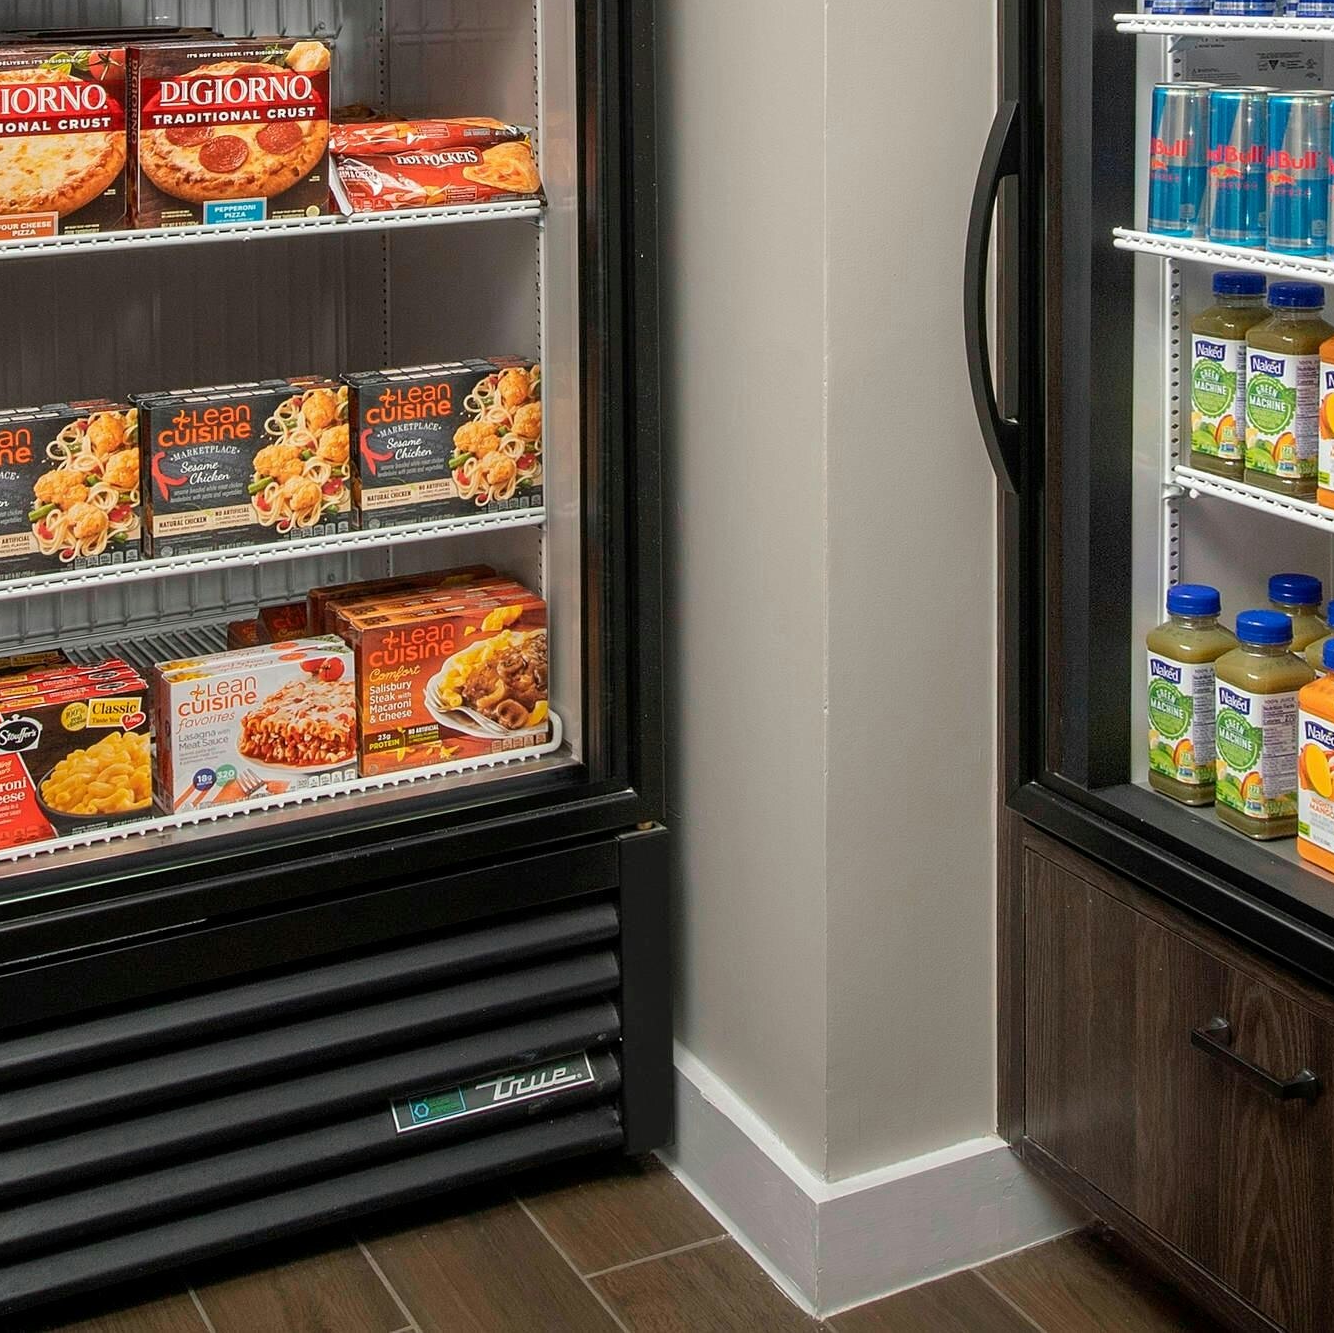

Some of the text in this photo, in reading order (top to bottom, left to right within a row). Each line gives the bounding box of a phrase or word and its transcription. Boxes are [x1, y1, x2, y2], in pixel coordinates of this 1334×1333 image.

[153, 106, 316, 125] TRADITIONAL CRUST
[422, 150, 478, 166] POCKETS
[214, 204, 257, 213] PEPPERONI
[224, 211, 246, 219] PIZZA
[20, 220, 52, 229] CHEESE
[12, 228, 36, 237] PIZZA
[1197, 342, 1223, 360] Naked
[1252, 356, 1282, 374] Naked
[1255, 385, 1279, 398] GREEN
[1249, 395, 1287, 412] MACHINE
[172, 446, 238, 459] MARKETPLACE
[180, 461, 220, 474] Sesame
[189, 471, 230, 486] Chicken
[369, 664, 421, 683] Comfort
[369, 679, 412, 696] Salisbury
[369, 692, 396, 704] Steak
[92, 702, 137, 715] Classic
[369, 699, 412, 715] Macaroni
[178, 710, 235, 734] favorites
[369, 709, 413, 724] & Cheese
[179, 729, 216, 742] Lasagna
[179, 736, 229, 751] Meat Sauce
[369, 738, 401, 751] PROTEIN
